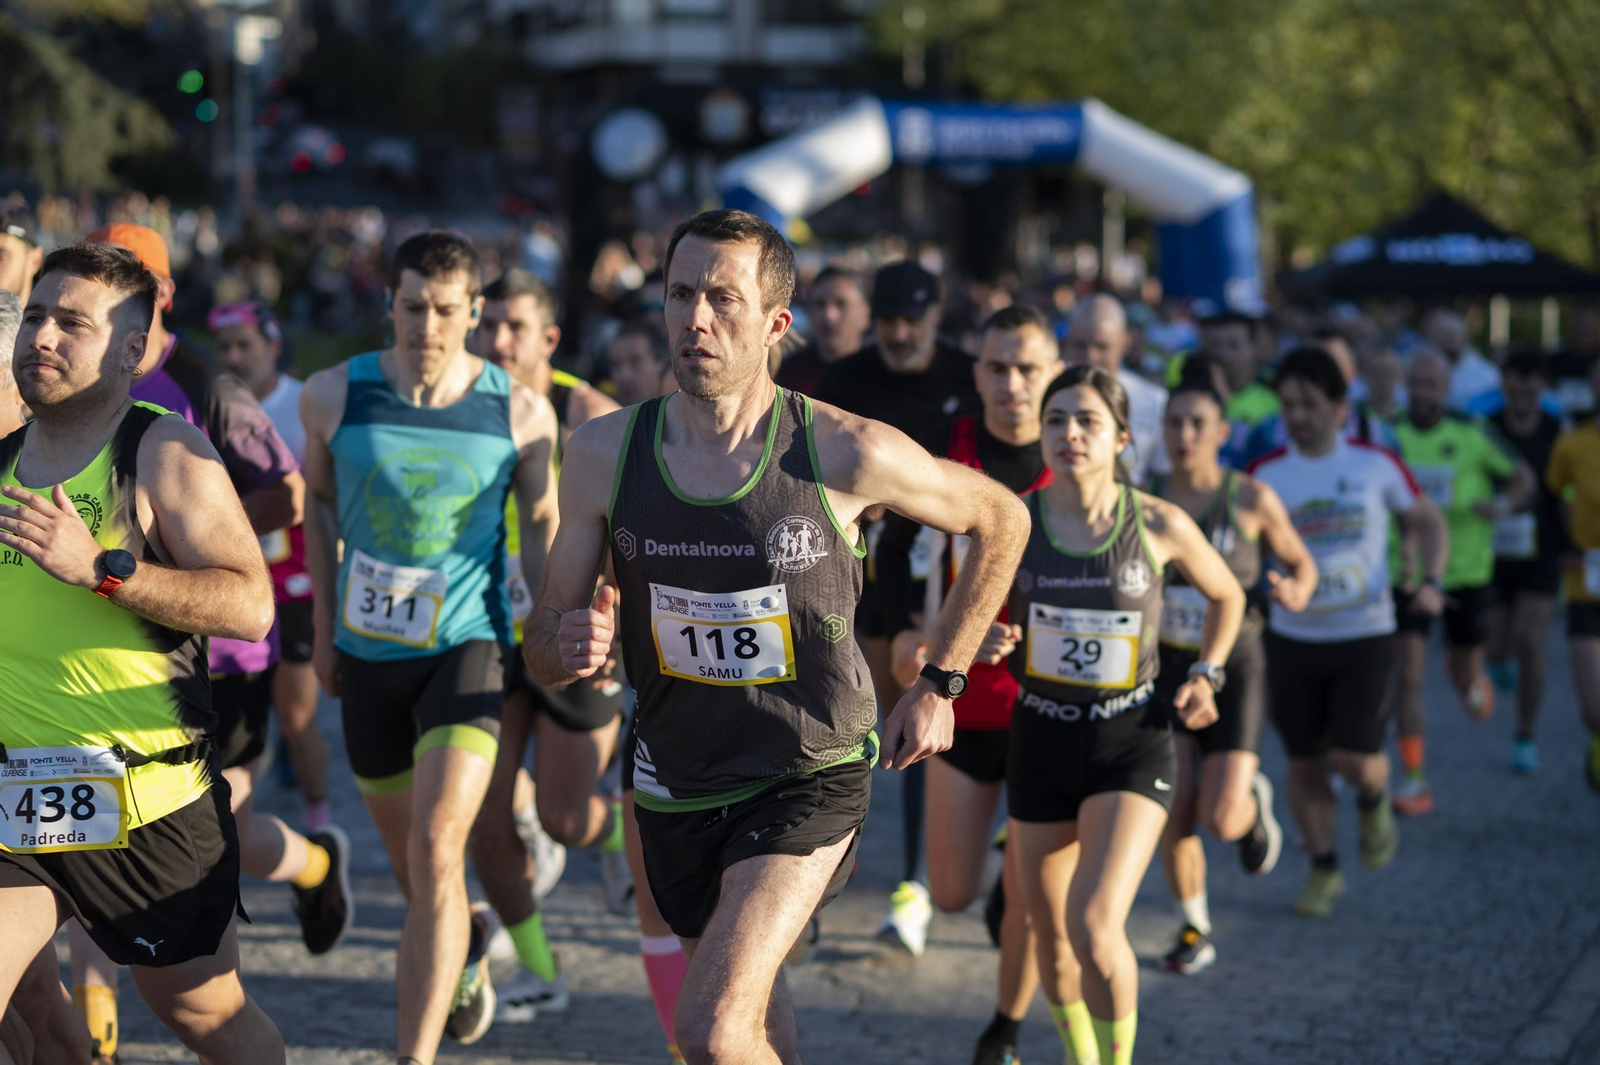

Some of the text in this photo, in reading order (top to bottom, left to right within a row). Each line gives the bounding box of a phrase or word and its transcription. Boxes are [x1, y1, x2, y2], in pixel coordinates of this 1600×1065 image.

[645, 539, 756, 557] Dentalnova
[1037, 575, 1112, 588] Dentalnova
[360, 586, 417, 621] 311
[690, 600, 712, 608] PONTE
[680, 626, 760, 660] 118
[1060, 637, 1102, 665] 29
[698, 665, 743, 679] SAMU
[1024, 691, 1081, 721] PRO
[15, 784, 96, 824] 438
[21, 830, 86, 846] Padreda
